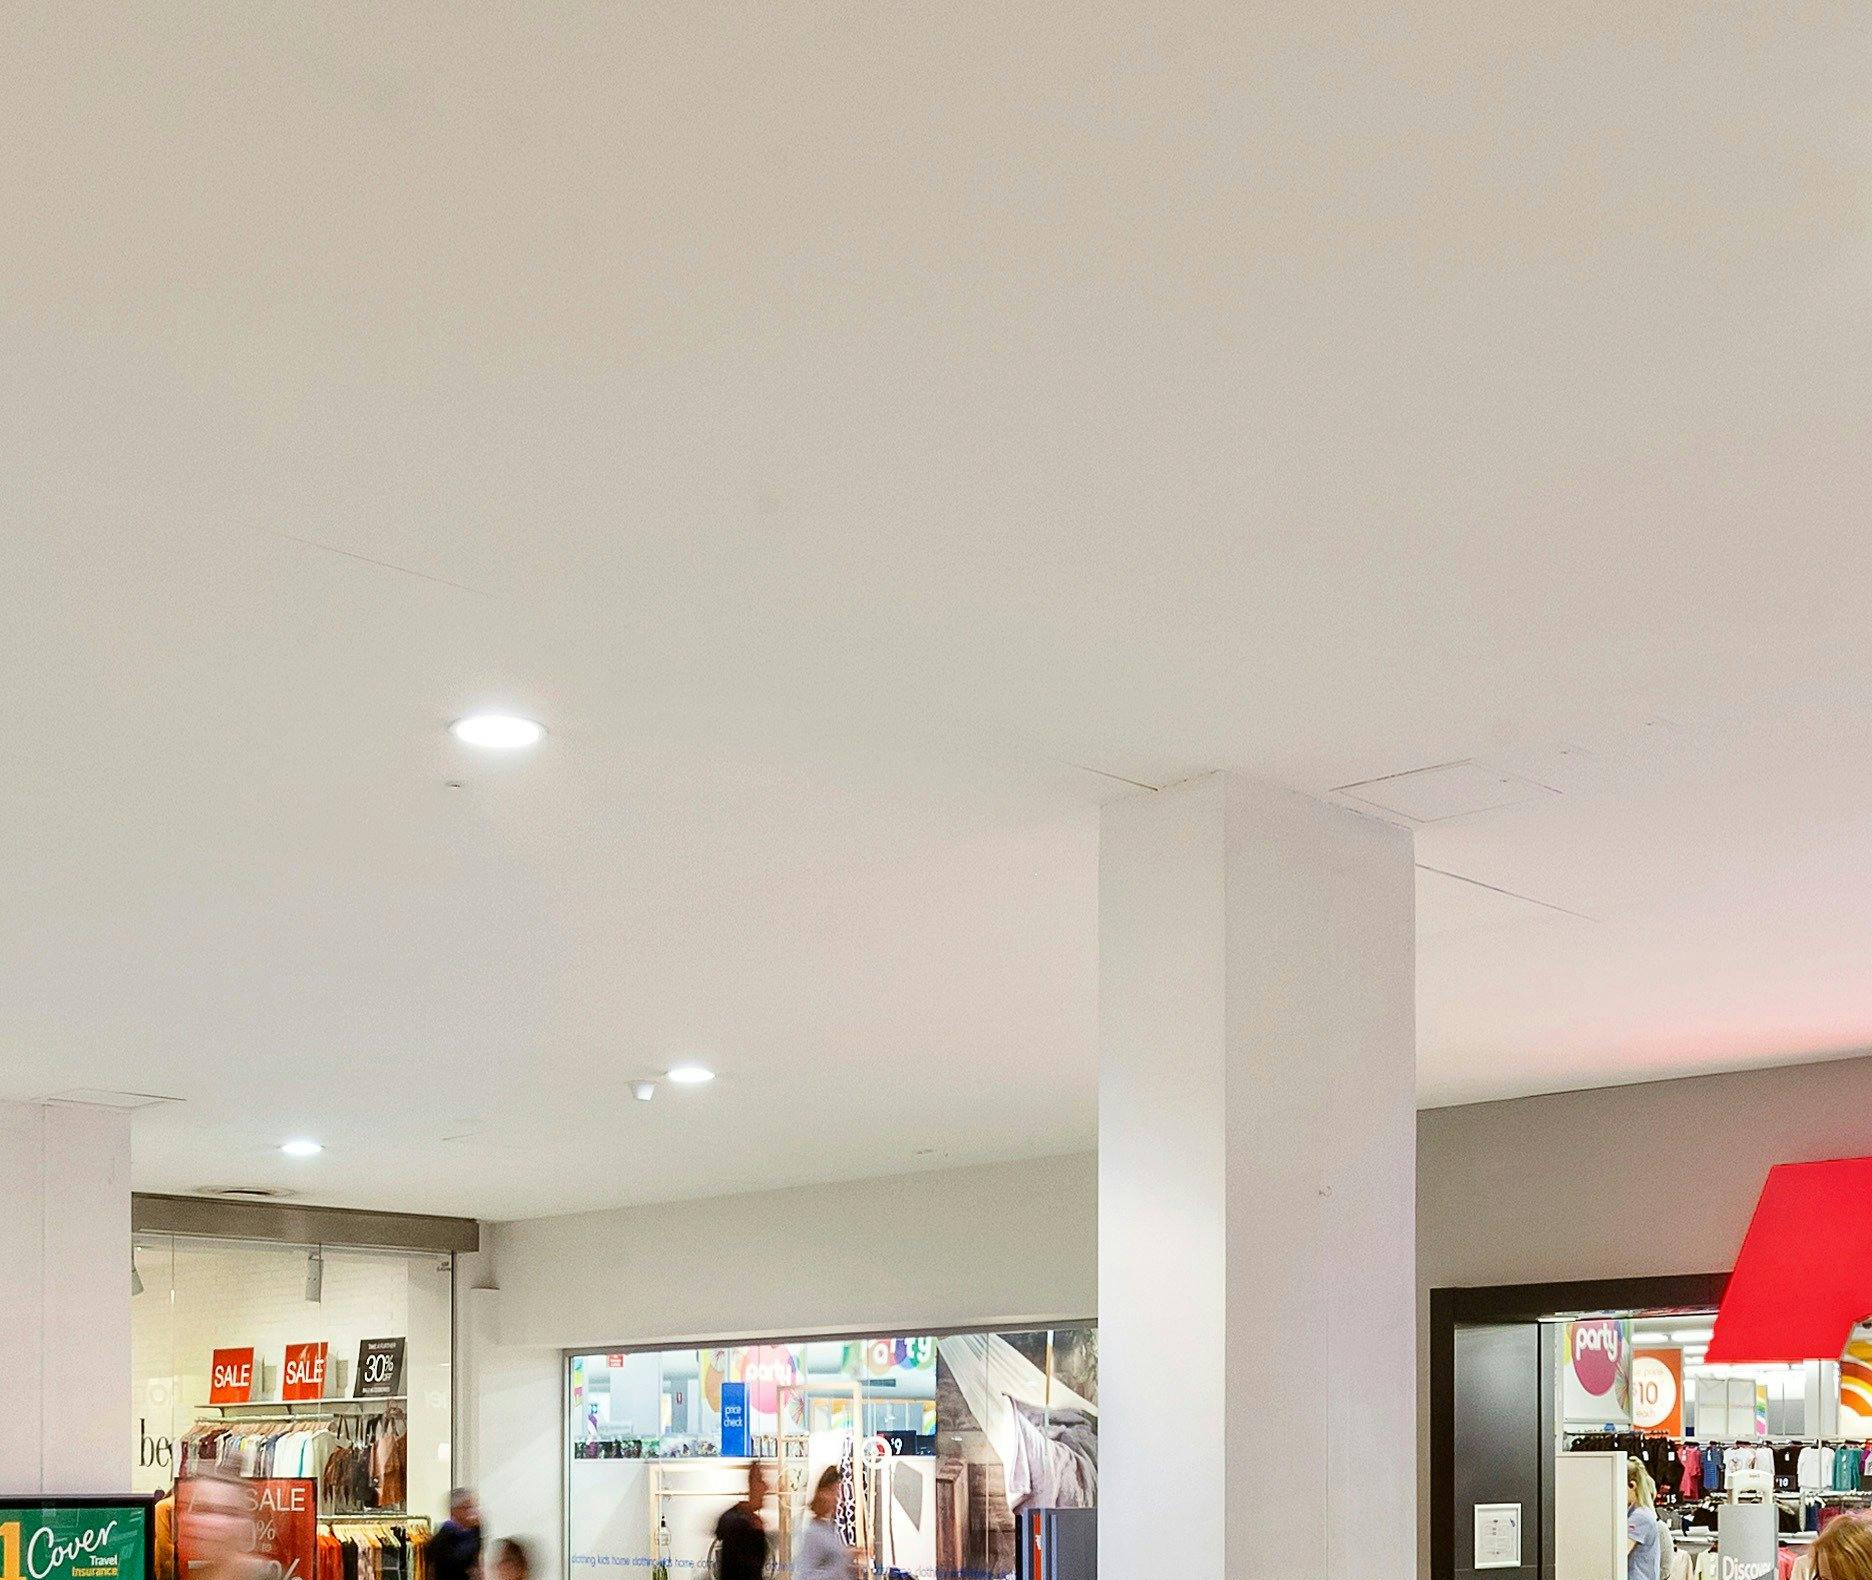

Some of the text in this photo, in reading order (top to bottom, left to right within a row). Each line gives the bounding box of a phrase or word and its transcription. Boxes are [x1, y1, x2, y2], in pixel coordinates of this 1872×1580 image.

[1576, 1322, 1618, 1362] party
[214, 1363, 251, 1388] SALE
[286, 1358, 325, 1385] SALE
[745, 1361, 795, 1385] party
[723, 1416, 743, 1428] check
[724, 1406, 742, 1417] price
[139, 1418, 173, 1468] be
[27, 1519, 118, 1580] Cover
[91, 1554, 118, 1567] Travel
[71, 1566, 119, 1578] Insurance
